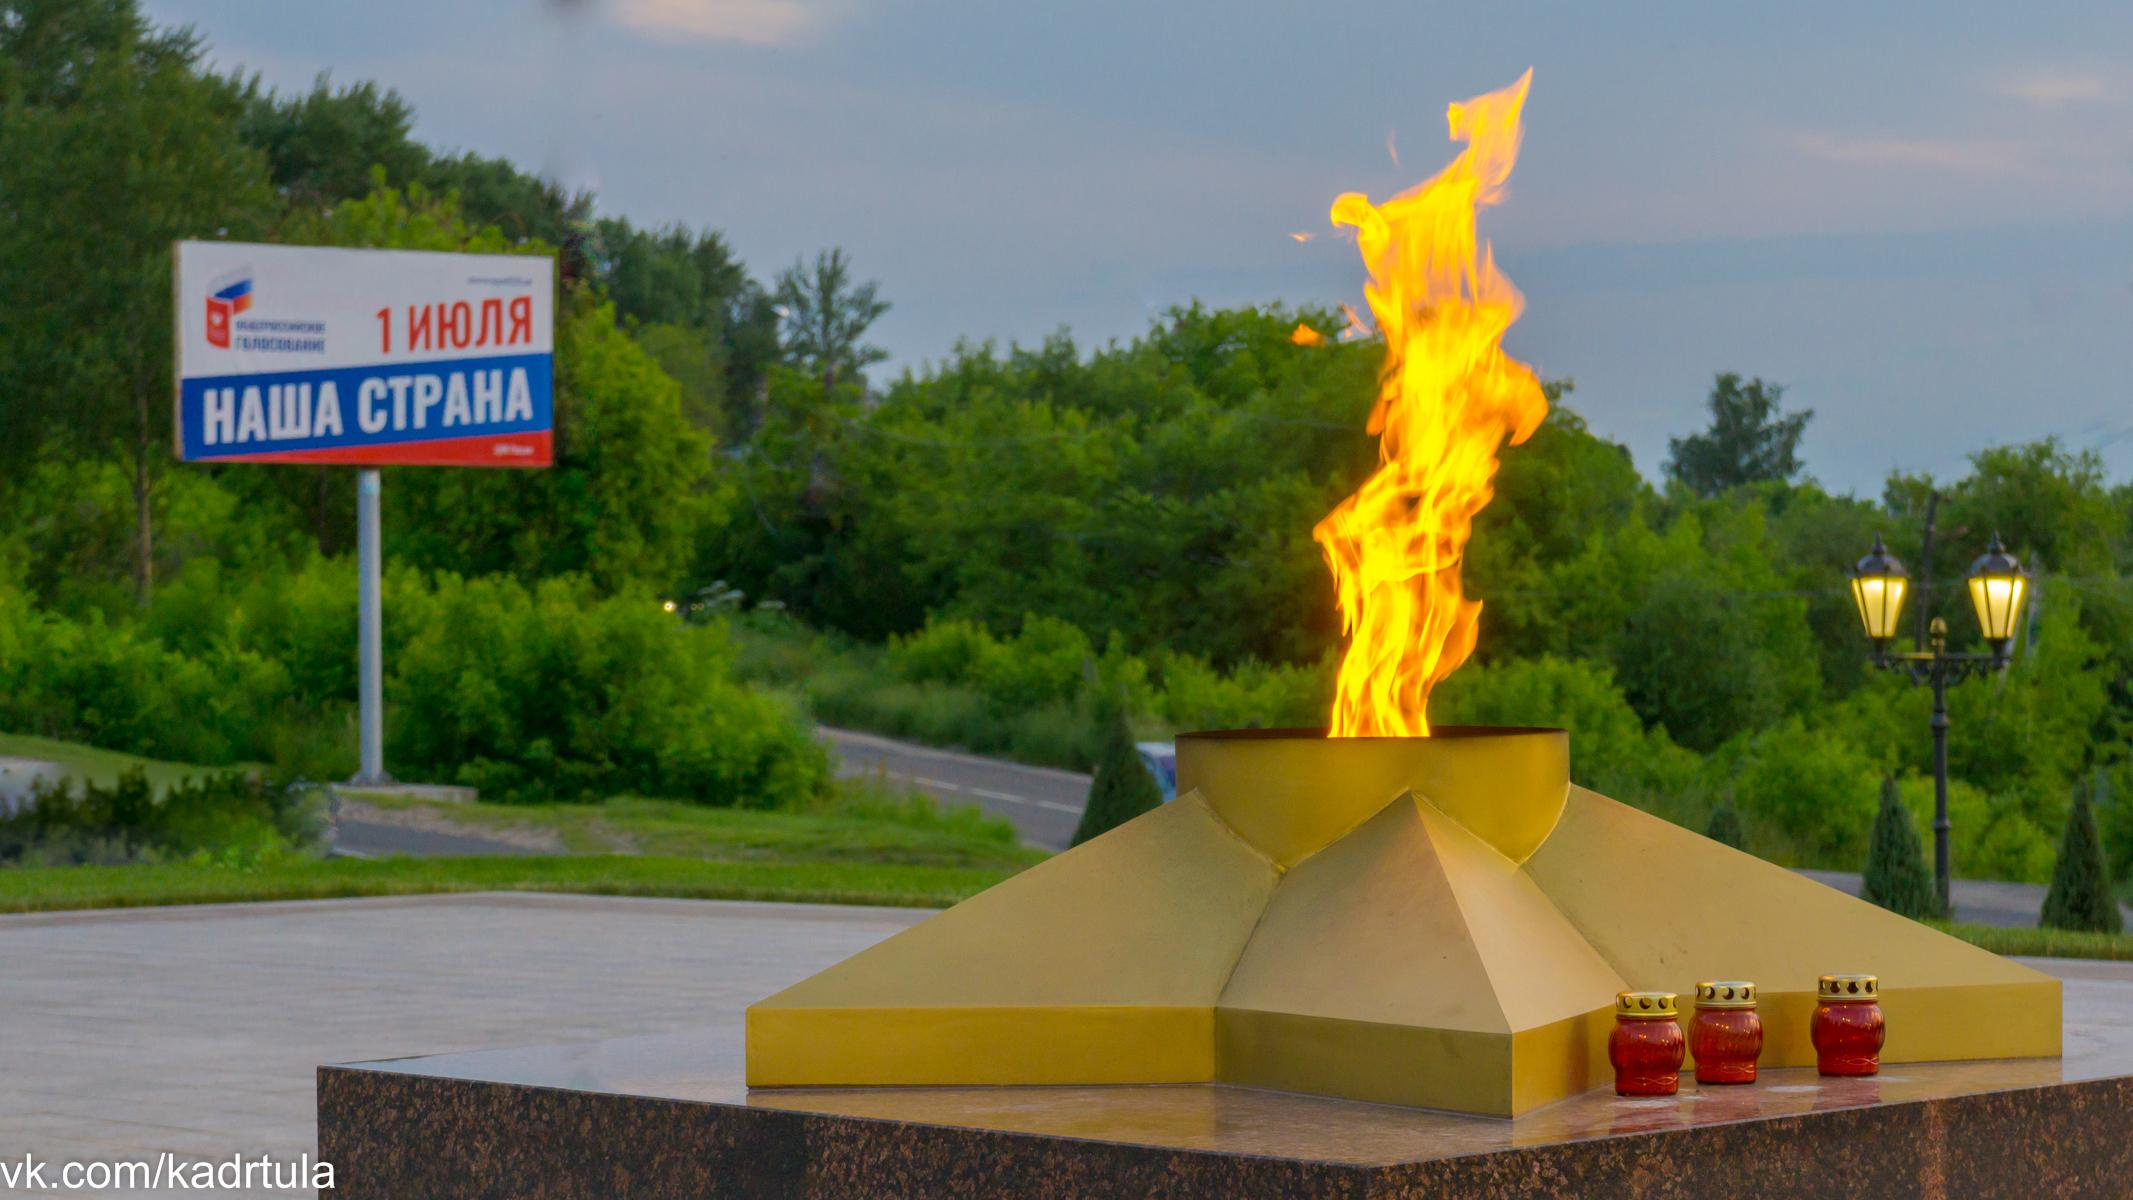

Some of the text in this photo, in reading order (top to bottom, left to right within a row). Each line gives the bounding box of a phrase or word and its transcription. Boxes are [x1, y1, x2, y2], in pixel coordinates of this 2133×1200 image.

[375, 295, 532, 354] 1 ИЮЛЯ
[203, 368, 534, 446] НАША СТРАНА
